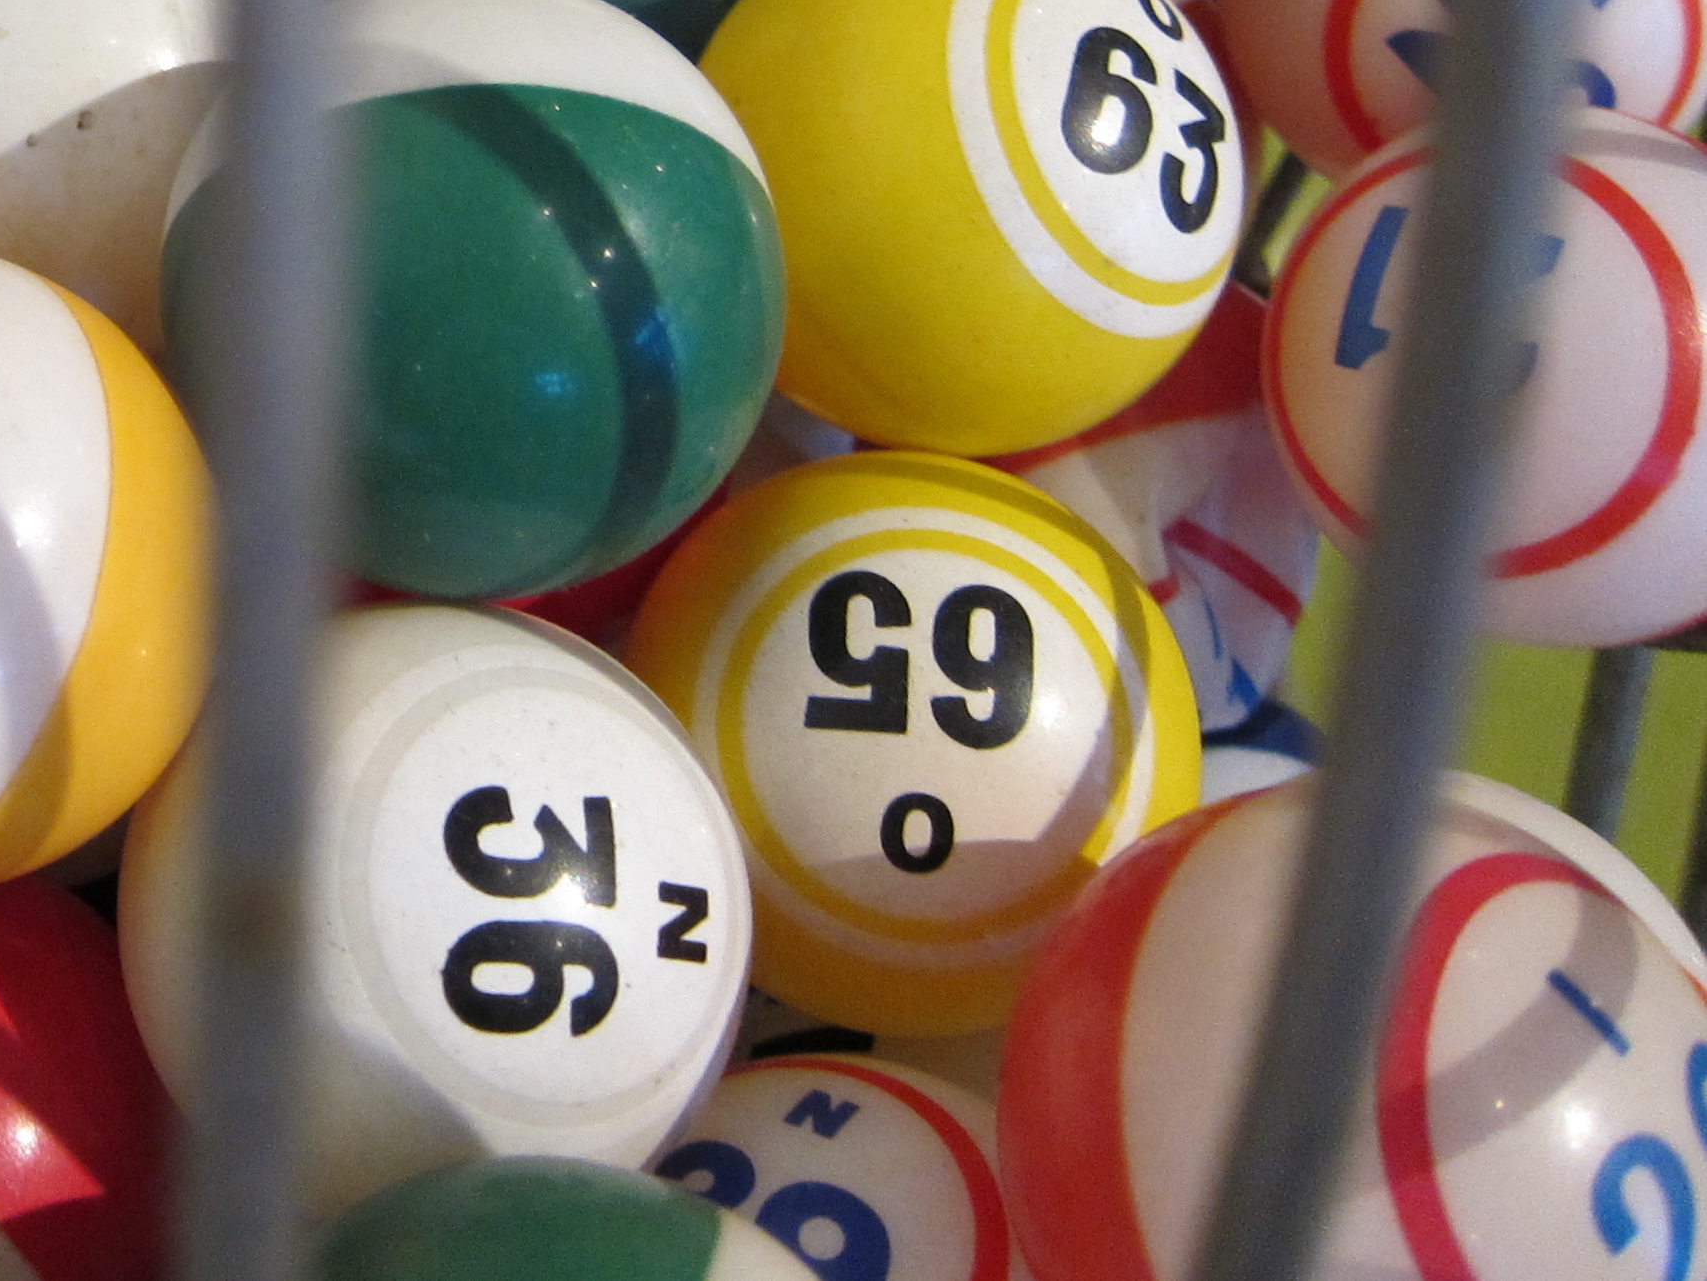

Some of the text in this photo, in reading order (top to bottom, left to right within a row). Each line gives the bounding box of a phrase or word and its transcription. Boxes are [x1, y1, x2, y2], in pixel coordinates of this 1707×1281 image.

[1061, 26, 1226, 234] 63
[803, 570, 1034, 750] 65
[880, 792, 954, 874] O
[442, 784, 619, 1037] 36
[657, 881, 708, 964] N
[782, 1089, 861, 1139] N
